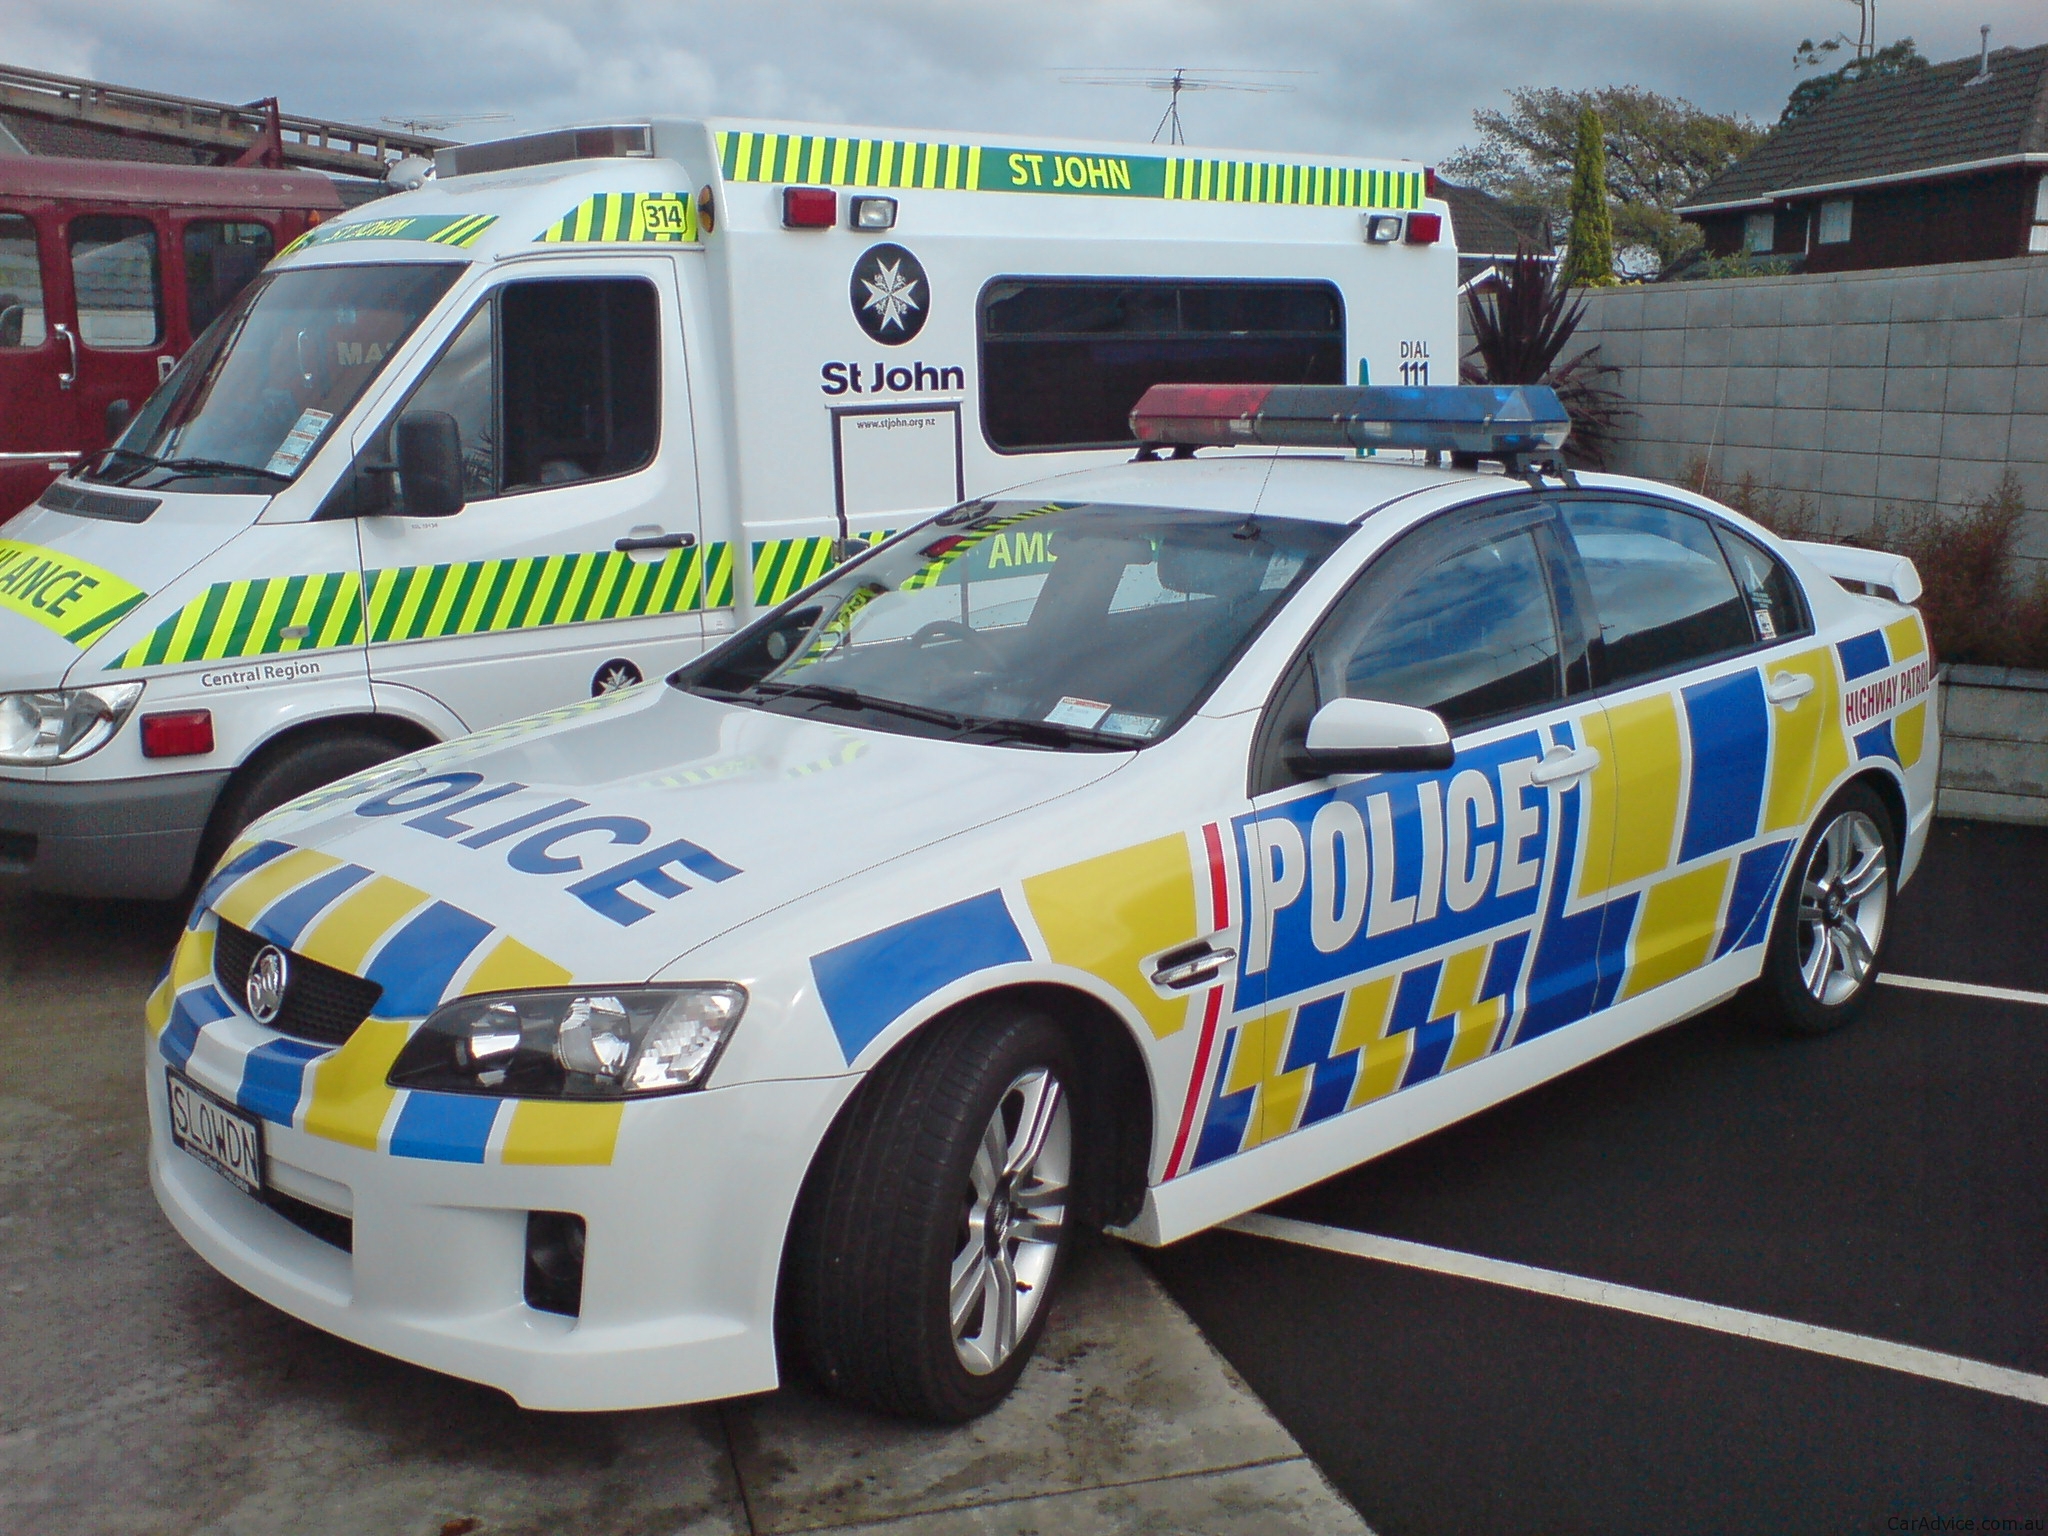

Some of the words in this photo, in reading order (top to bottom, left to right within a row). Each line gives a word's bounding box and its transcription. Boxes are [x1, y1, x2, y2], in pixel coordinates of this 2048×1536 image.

[1008, 153, 1044, 186] ST
[1053, 156, 1131, 190] JOHN
[646, 205, 682, 228] 314
[337, 342, 394, 366] MA
[1400, 340, 1430, 359] DIAL
[821, 361, 863, 395] St
[870, 361, 965, 393] John
[1399, 361, 1429, 386] 111
[201, 667, 260, 687] Central
[264, 661, 320, 680] Region
[1845, 674, 1899, 726] HIGHWAY
[1243, 755, 1542, 975] POLICE
[173, 1085, 259, 1182] SLOWDN
